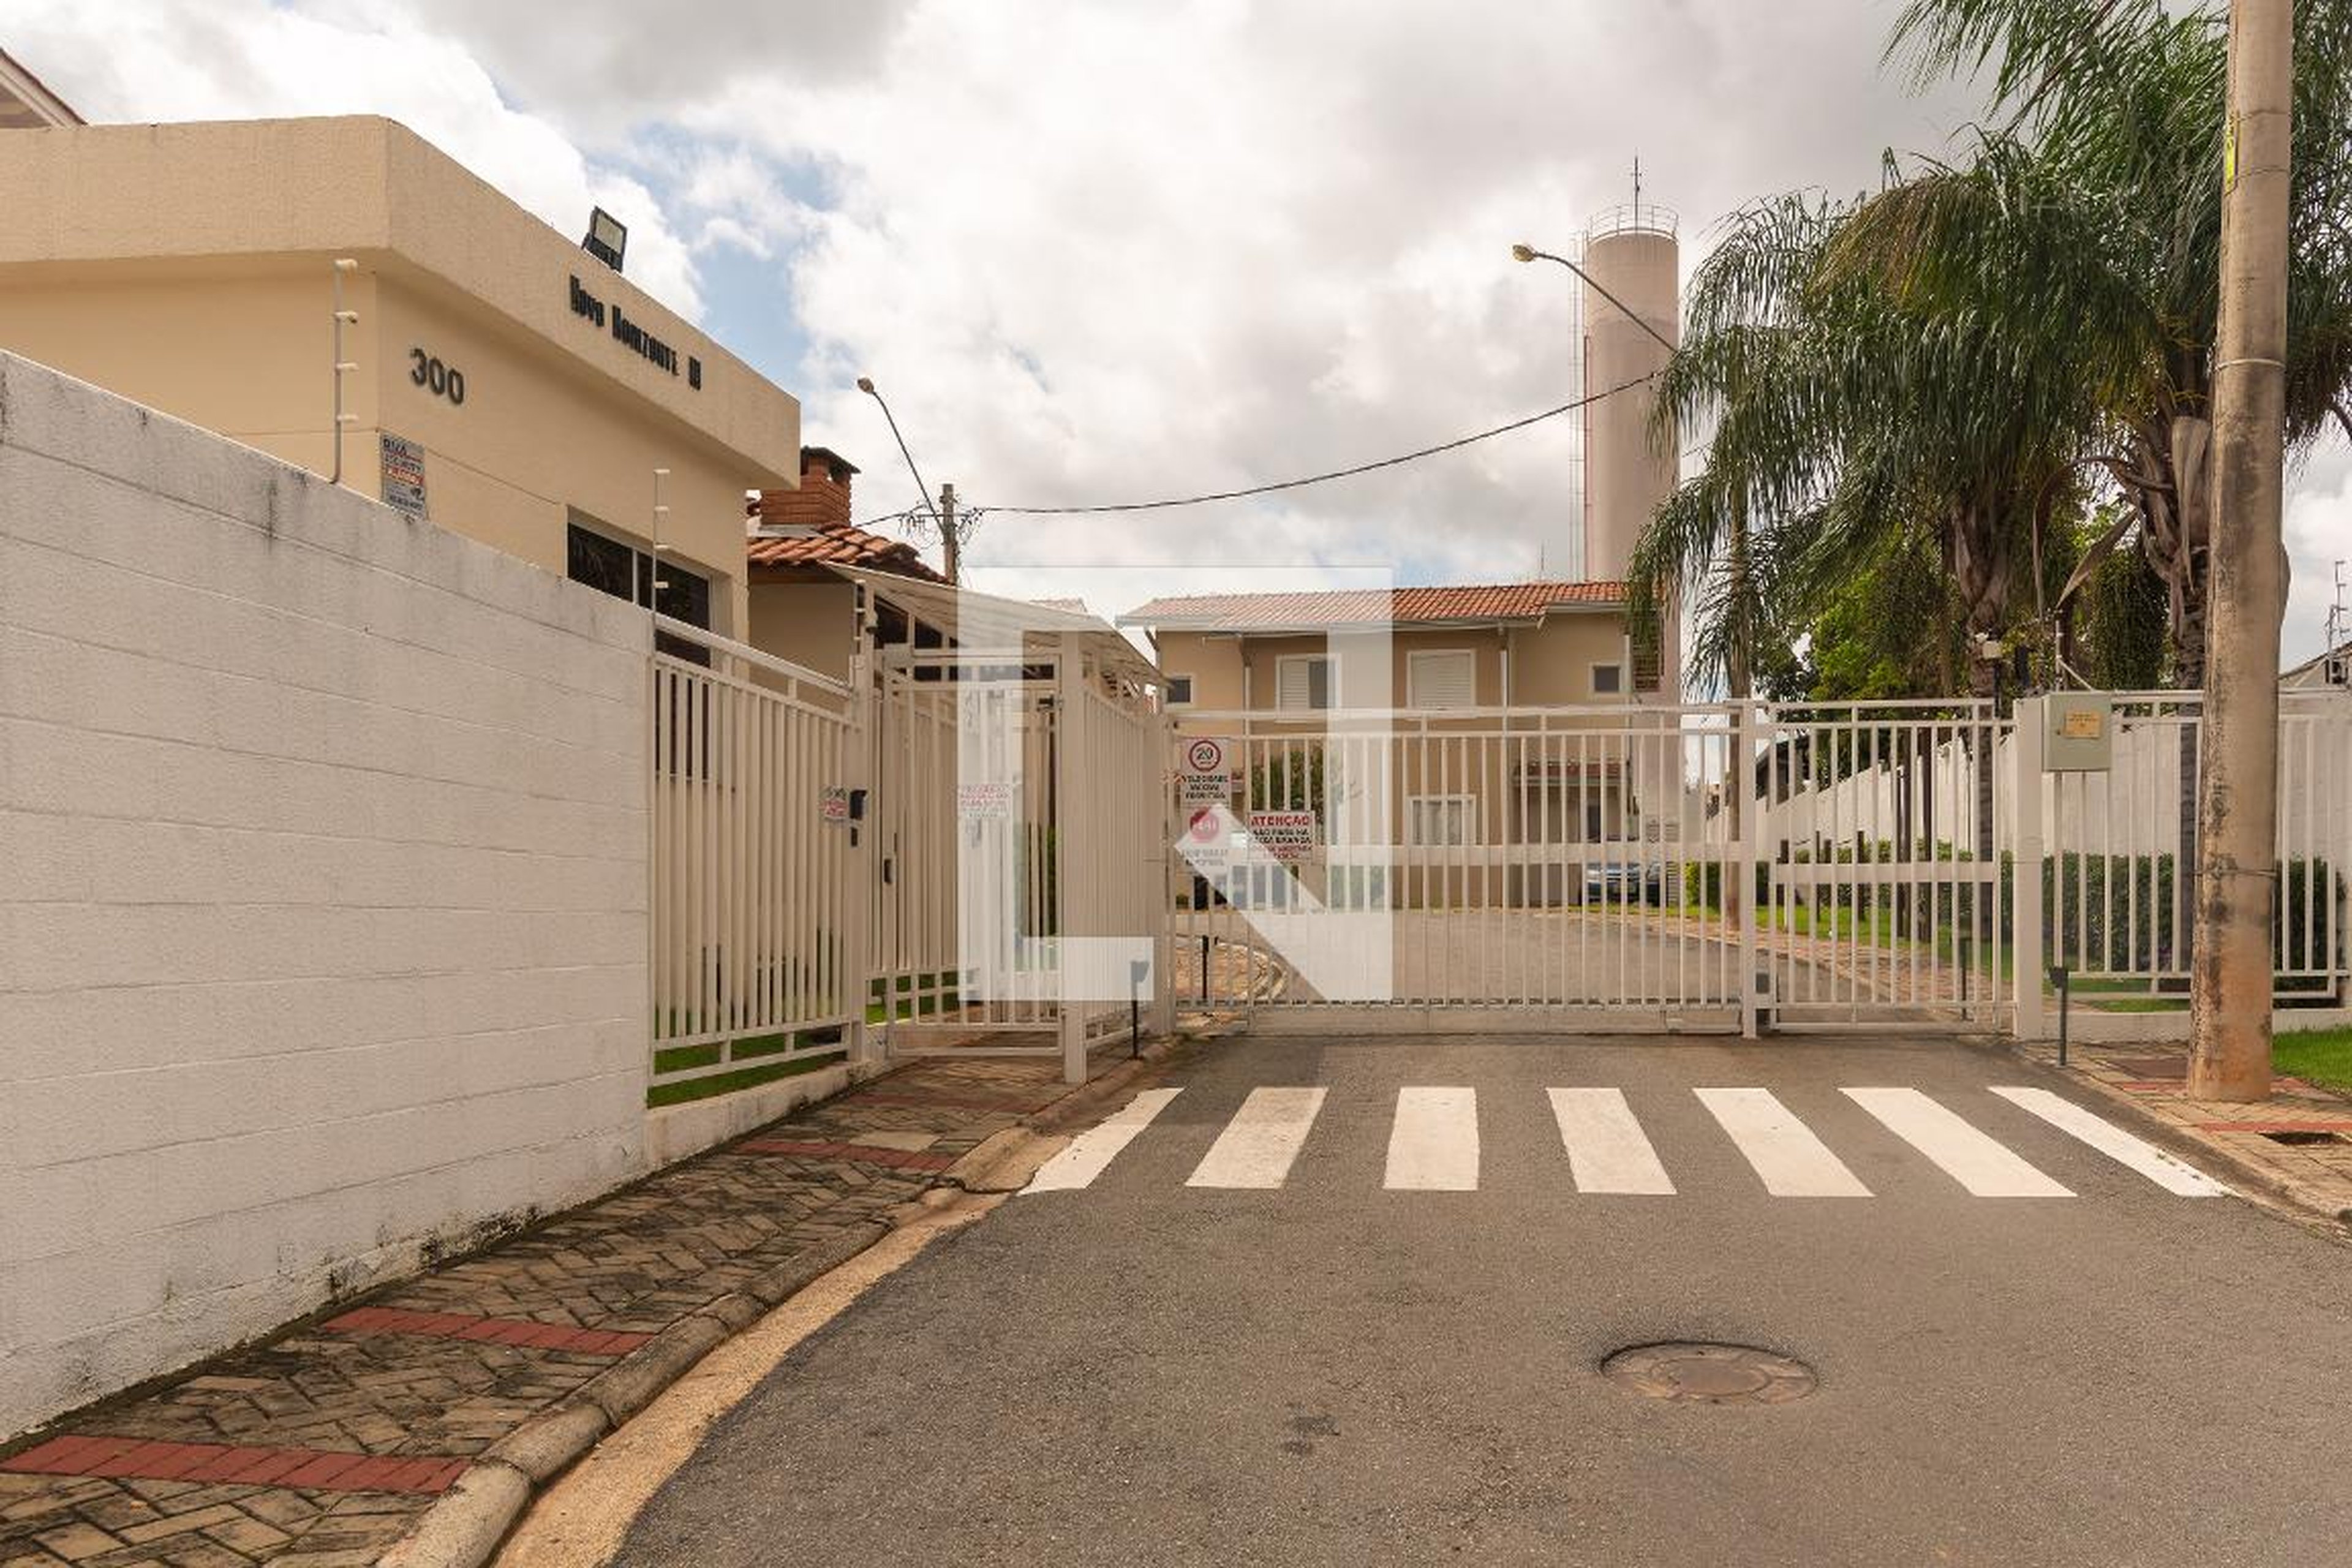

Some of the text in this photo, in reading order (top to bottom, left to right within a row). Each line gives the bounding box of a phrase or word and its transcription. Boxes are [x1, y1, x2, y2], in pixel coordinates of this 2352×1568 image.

[411, 348, 464, 405] 300
[1196, 746, 1214, 760] 20
[1251, 815, 1310, 826] ATENÇÃO
